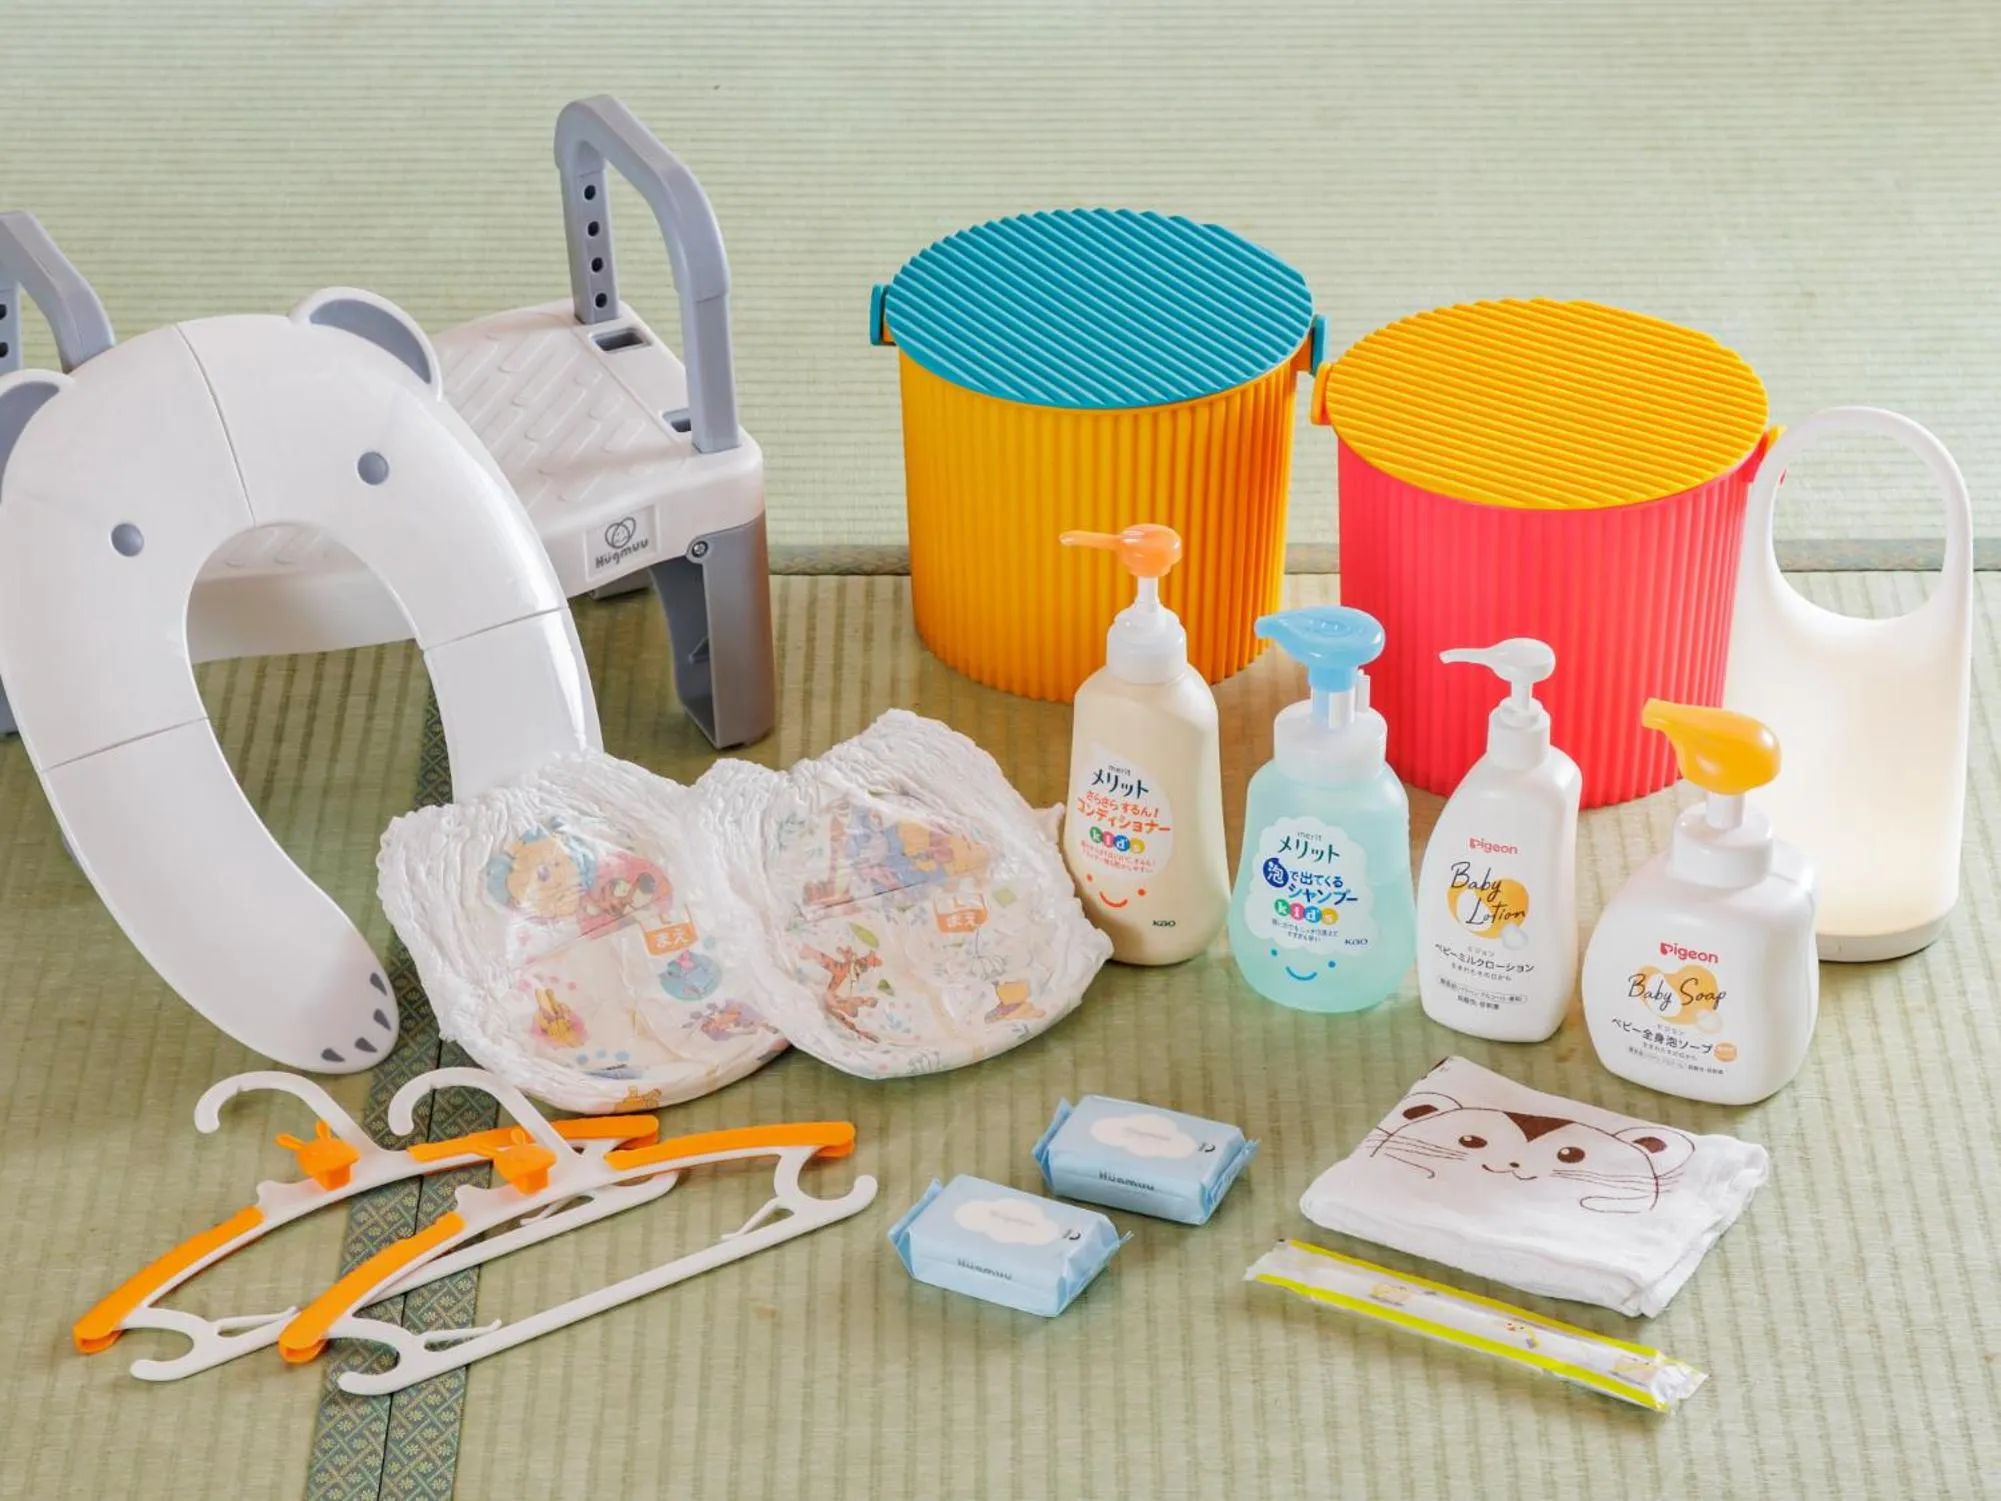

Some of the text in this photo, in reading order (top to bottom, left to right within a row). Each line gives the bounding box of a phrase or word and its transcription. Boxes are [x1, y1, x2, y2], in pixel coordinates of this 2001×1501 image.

[1091, 769, 1149, 799] メリット
[1077, 799, 1171, 833] コンディショナー
[1278, 835, 1340, 864] メリット
[1297, 831, 1322, 842] merit
[1263, 857, 1344, 889] 泡で出てくる
[1451, 861, 1502, 902] Baby
[1288, 883, 1358, 906] シャンプー
[1465, 898, 1526, 925] Lotion
[1434, 943, 1535, 973] ベビーミルクローション
[1660, 942, 1719, 963] Pigeon
[1628, 973, 1727, 1012] Baby Soap
[1611, 1017, 1714, 1054] ベビー全身泡ソープ
